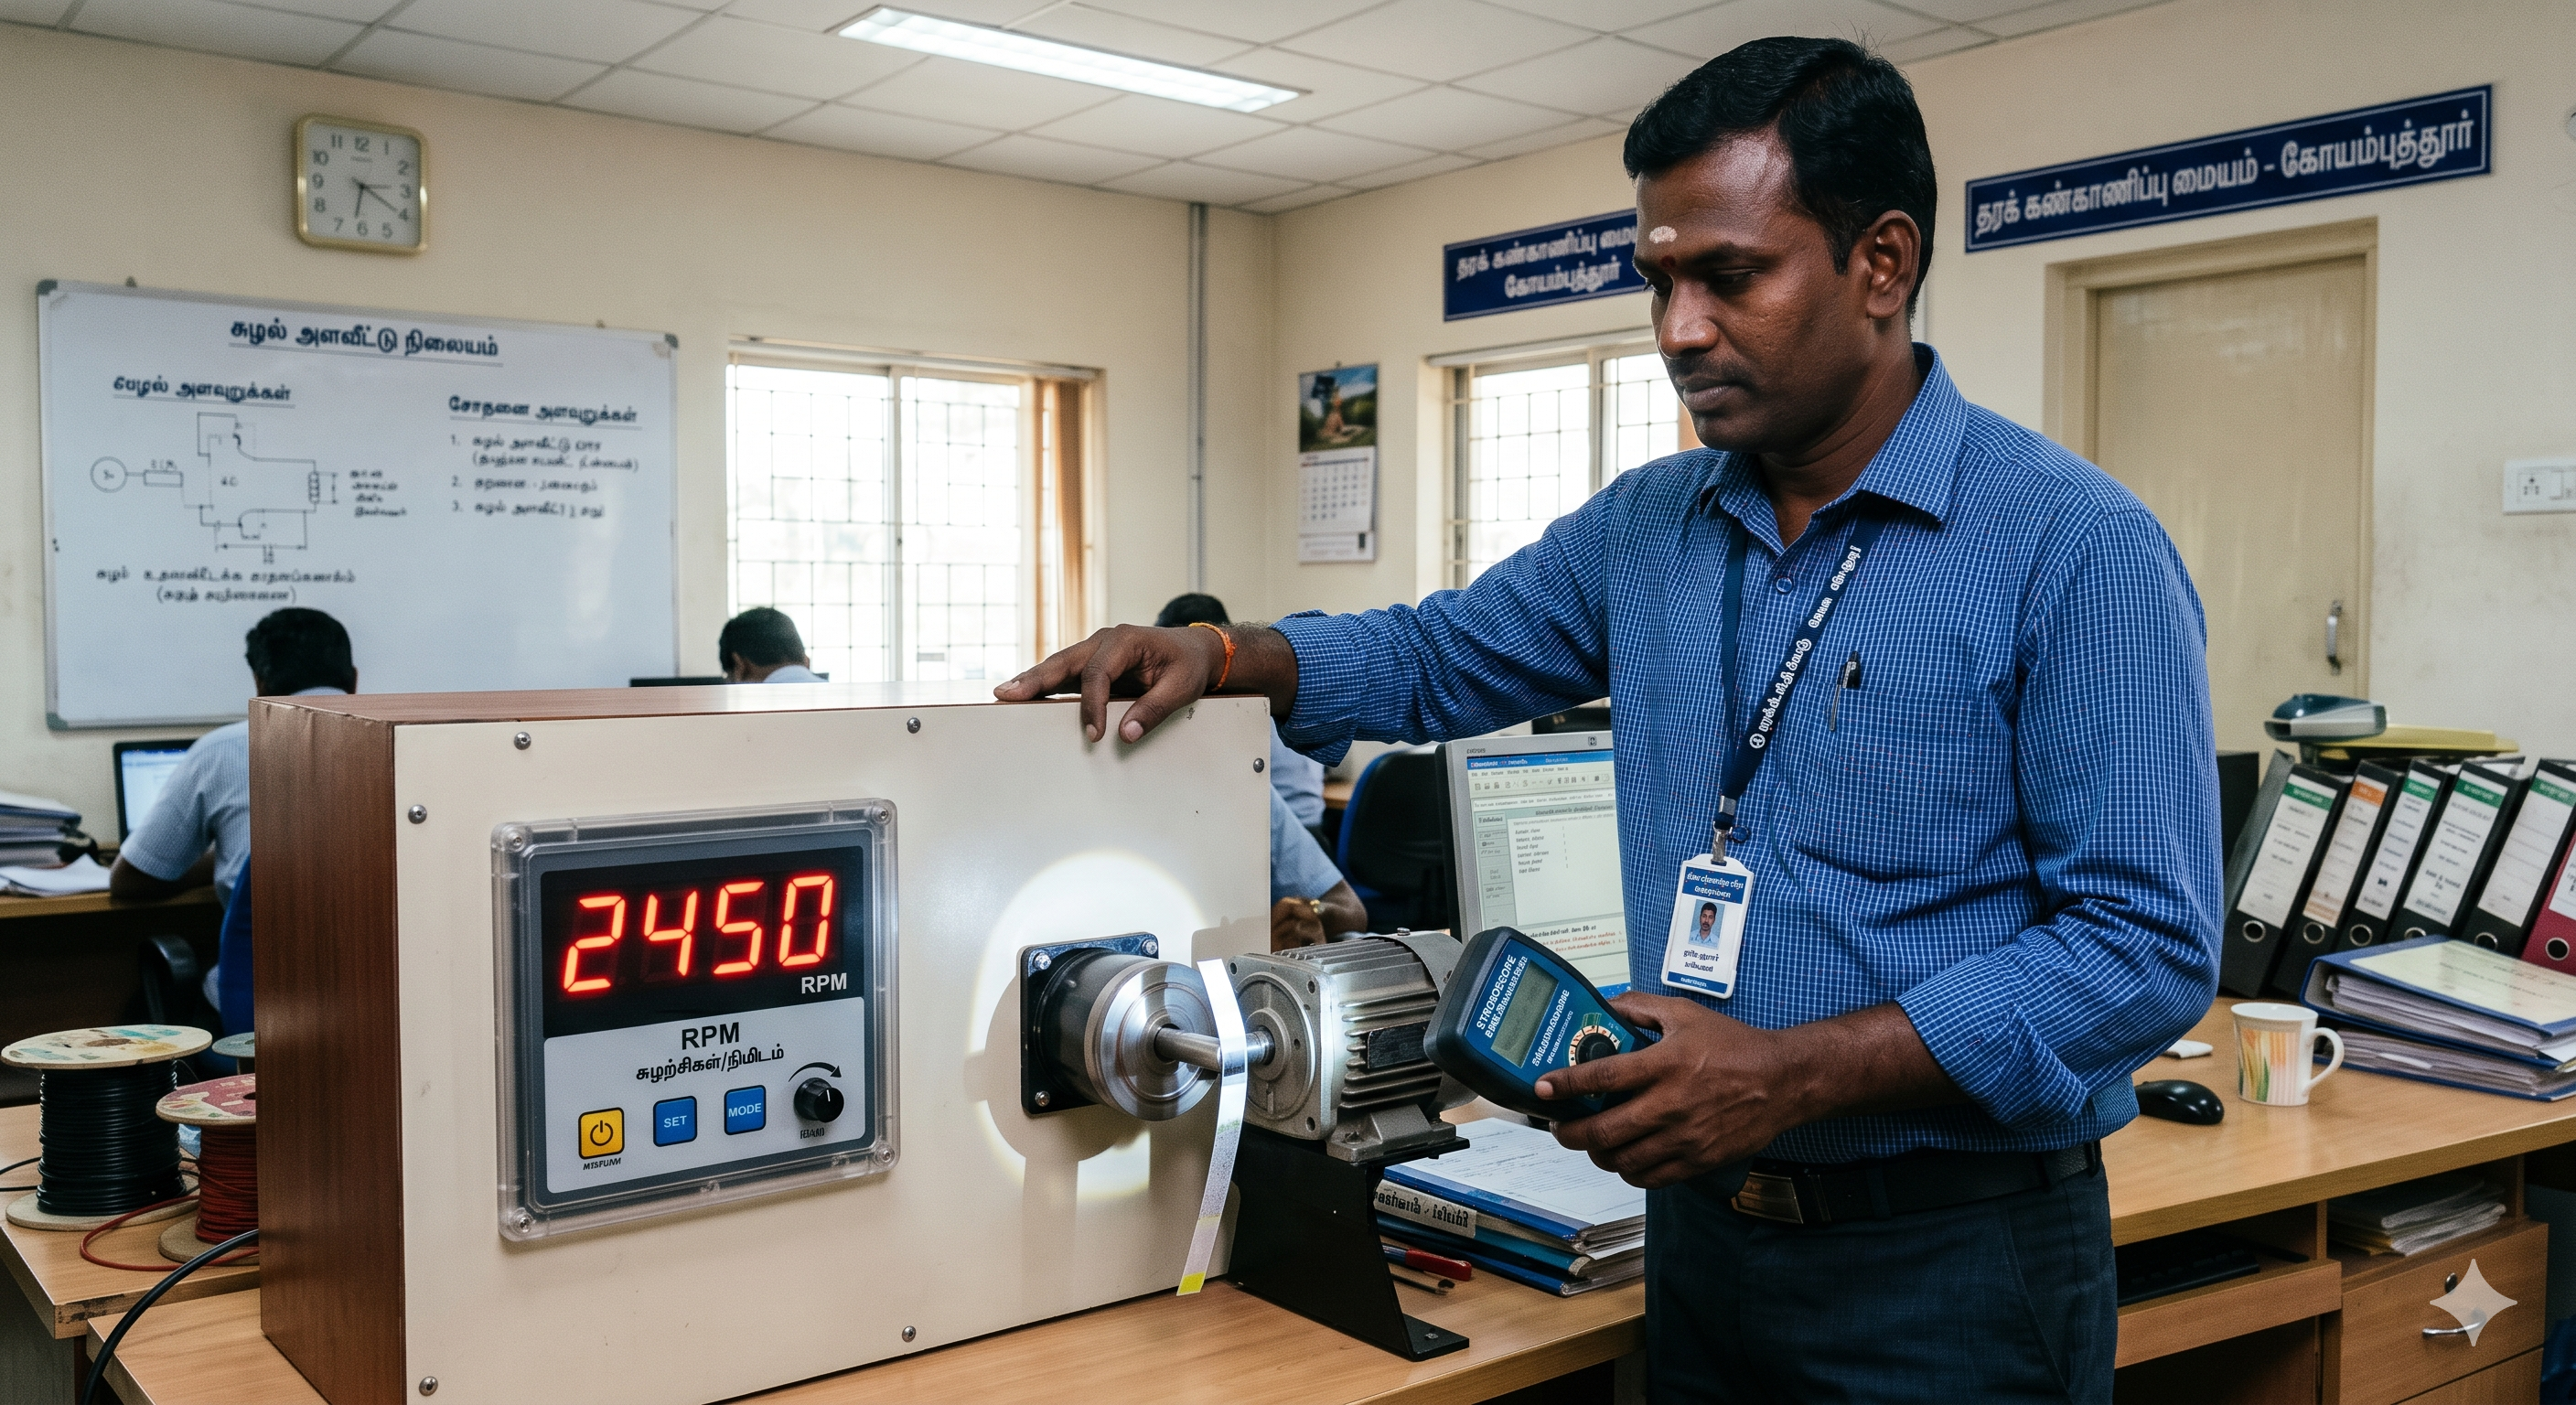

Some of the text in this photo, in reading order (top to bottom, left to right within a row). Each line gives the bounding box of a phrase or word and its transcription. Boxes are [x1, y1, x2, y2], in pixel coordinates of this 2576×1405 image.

[331, 134, 343, 149] 11
[354, 136, 370, 152] 12
[312, 149, 329, 166] 10
[397, 160, 410, 176] 2
[1975, 188, 2021, 239] தரக்
[2024, 166, 2168, 220] கண்காணிப்பு
[2172, 147, 2259, 196] மையம்
[2281, 109, 2474, 178] கோயம்புத்தூர்
[312, 172, 324, 189] 9
[401, 183, 412, 199] 3
[314, 197, 326, 213] 8
[398, 208, 409, 222] 4
[334, 216, 344, 232] 7
[357, 220, 368, 237] 6
[381, 222, 393, 239] 5
[1456, 247, 1490, 282] தரக்
[1492, 228, 1597, 270] கண்காணிப்பு
[231, 316, 499, 357] சுழல் அளவீட்டு நிலையம்
[563, 874, 833, 993] 2450
[801, 972, 847, 994] RPM
[682, 1022, 740, 1050] RPM
[636, 1043, 784, 1083] சுழற்சிகள்/நிமிடம்
[728, 1102, 762, 1118] MODE
[663, 1115, 687, 1128] SET
